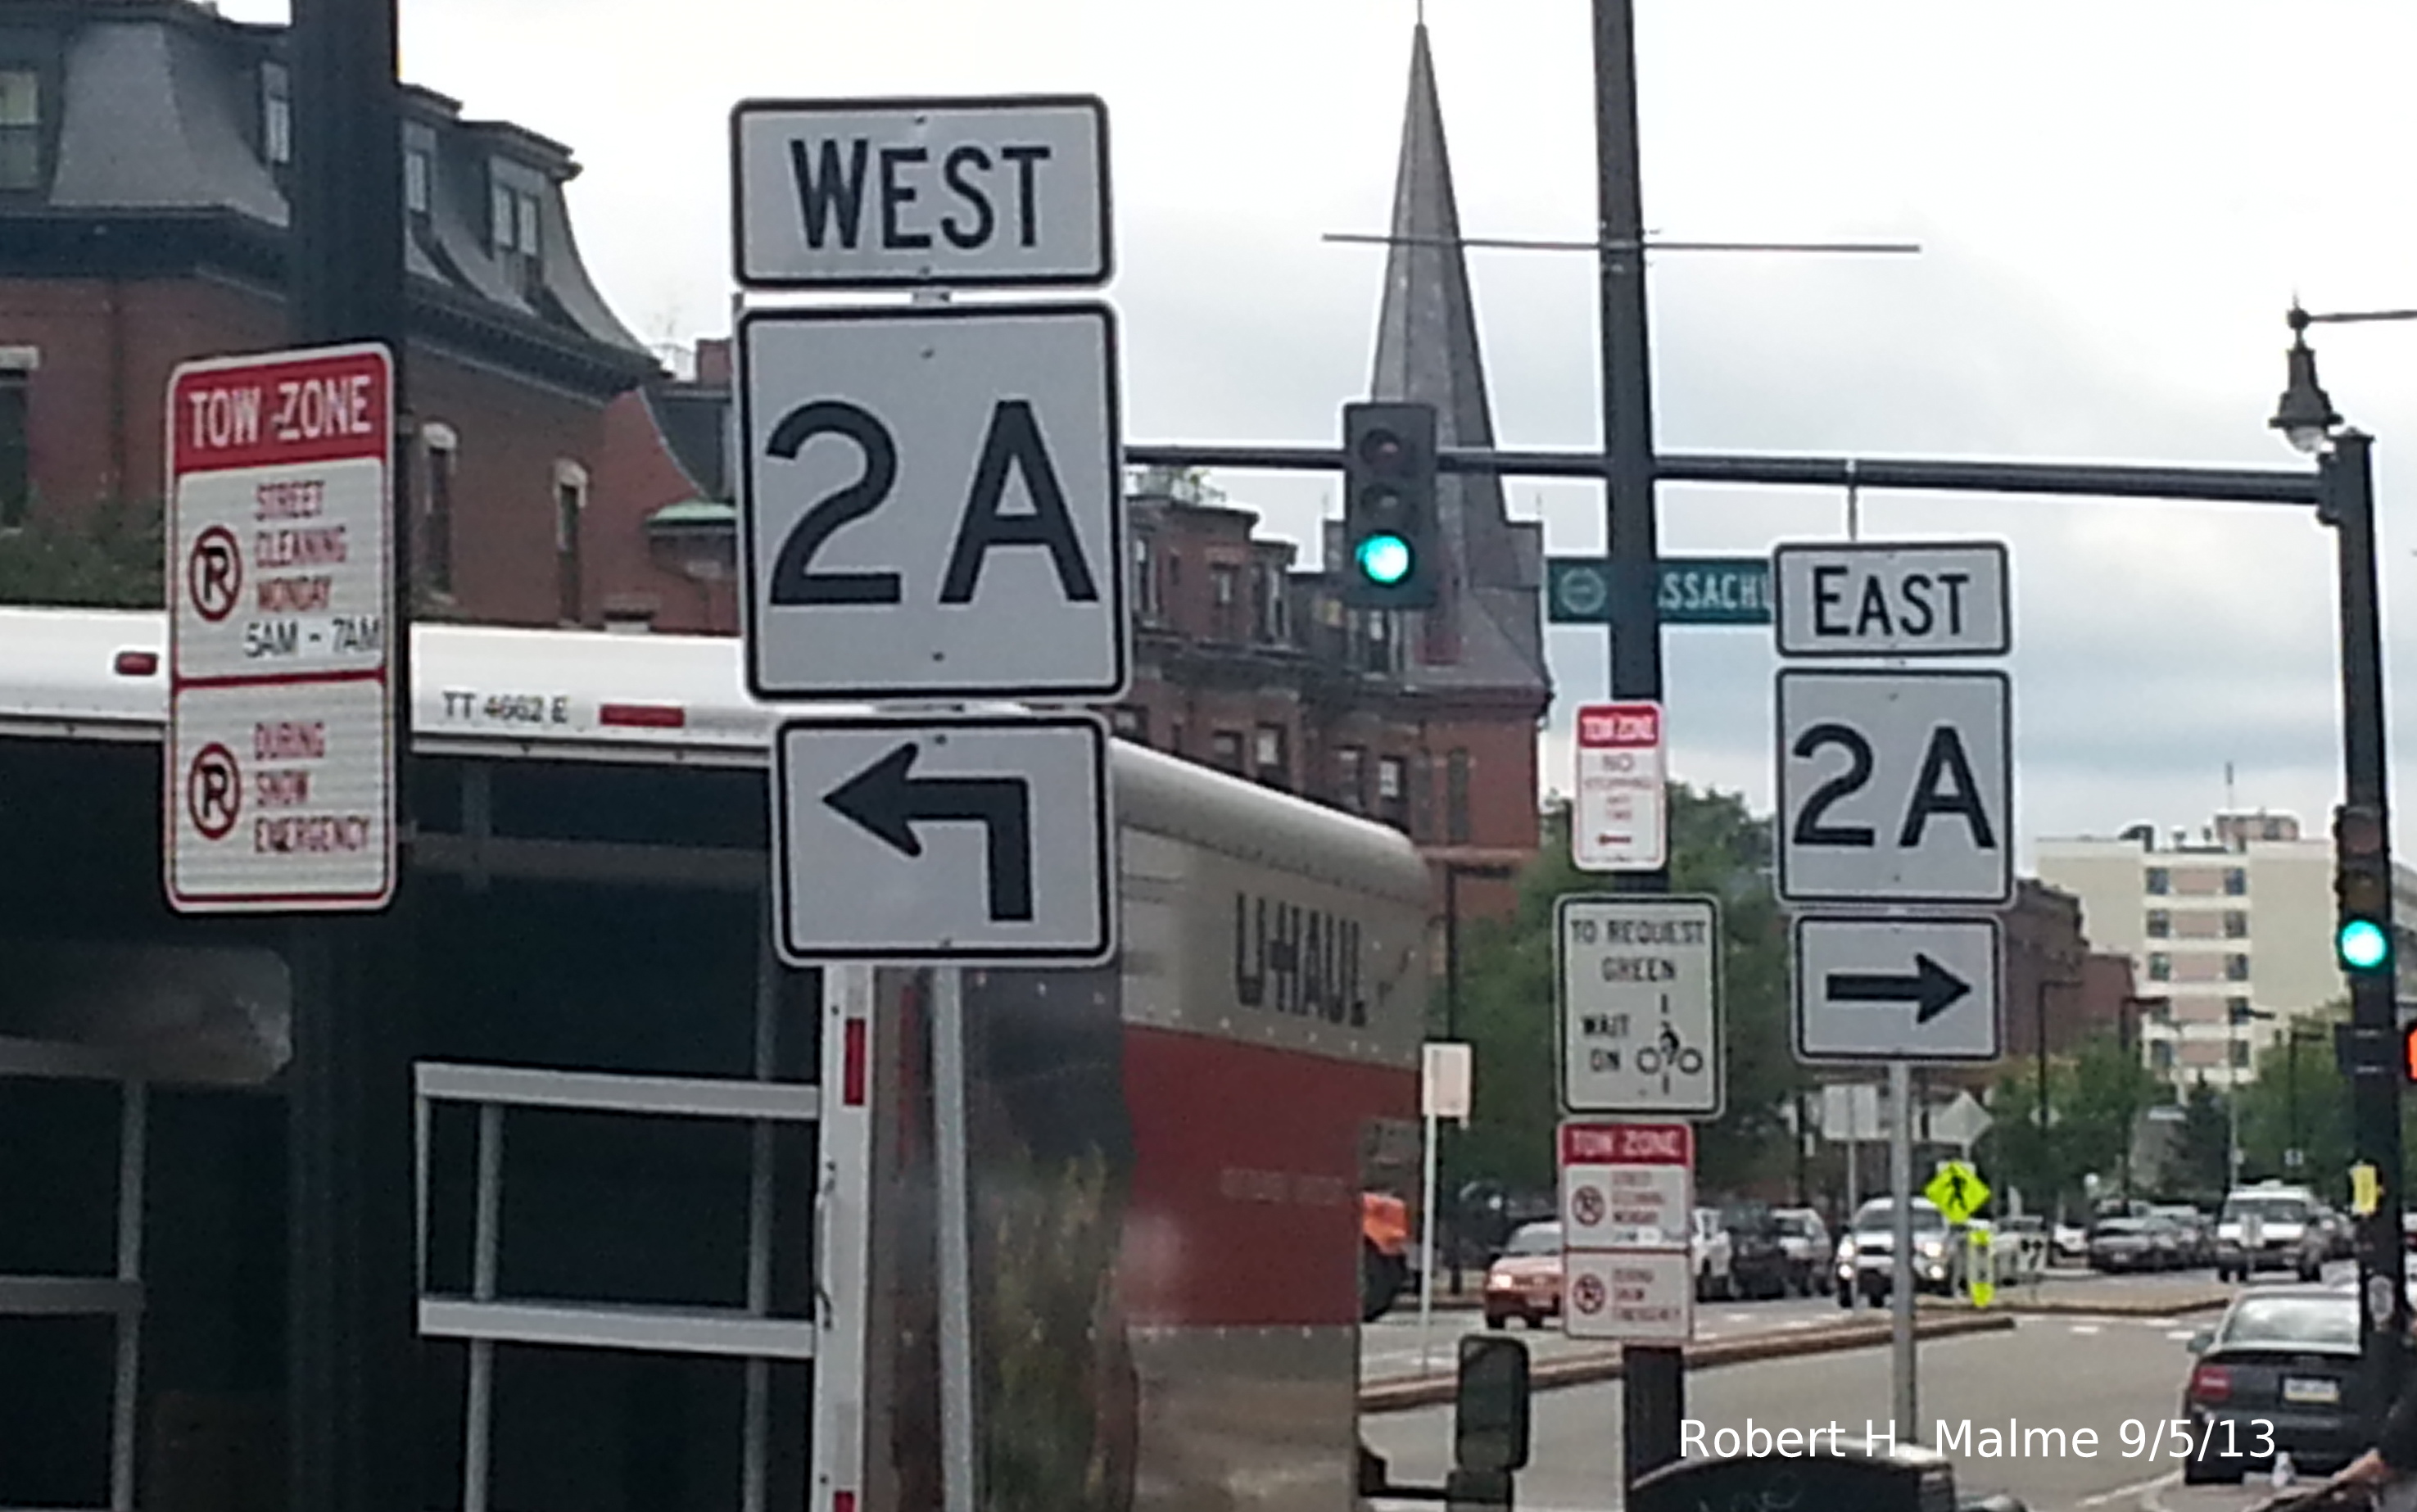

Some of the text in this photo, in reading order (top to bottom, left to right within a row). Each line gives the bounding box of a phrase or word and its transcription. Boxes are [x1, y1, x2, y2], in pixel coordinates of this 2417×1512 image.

[790, 138, 1052, 249] WEST
[188, 374, 373, 449] TOW ZONE
[255, 479, 325, 522] STREET
[765, 399, 1099, 606] 2A
[254, 524, 346, 568] CLEANING
[256, 574, 332, 612] MONDAY
[1812, 565, 1970, 636] EAST
[245, 620, 299, 659] 5AM
[332, 618, 380, 654] 7AM
[442, 691, 478, 719] TT
[255, 722, 325, 761] DURING
[256, 770, 310, 808] SNOW
[1792, 723, 1998, 849] 2A
[1570, 919, 1706, 945] TO REQUEST
[1601, 956, 1676, 982] GREEN
[1582, 1014, 1629, 1038] WAIT
[1590, 1048, 1621, 1072] ON
